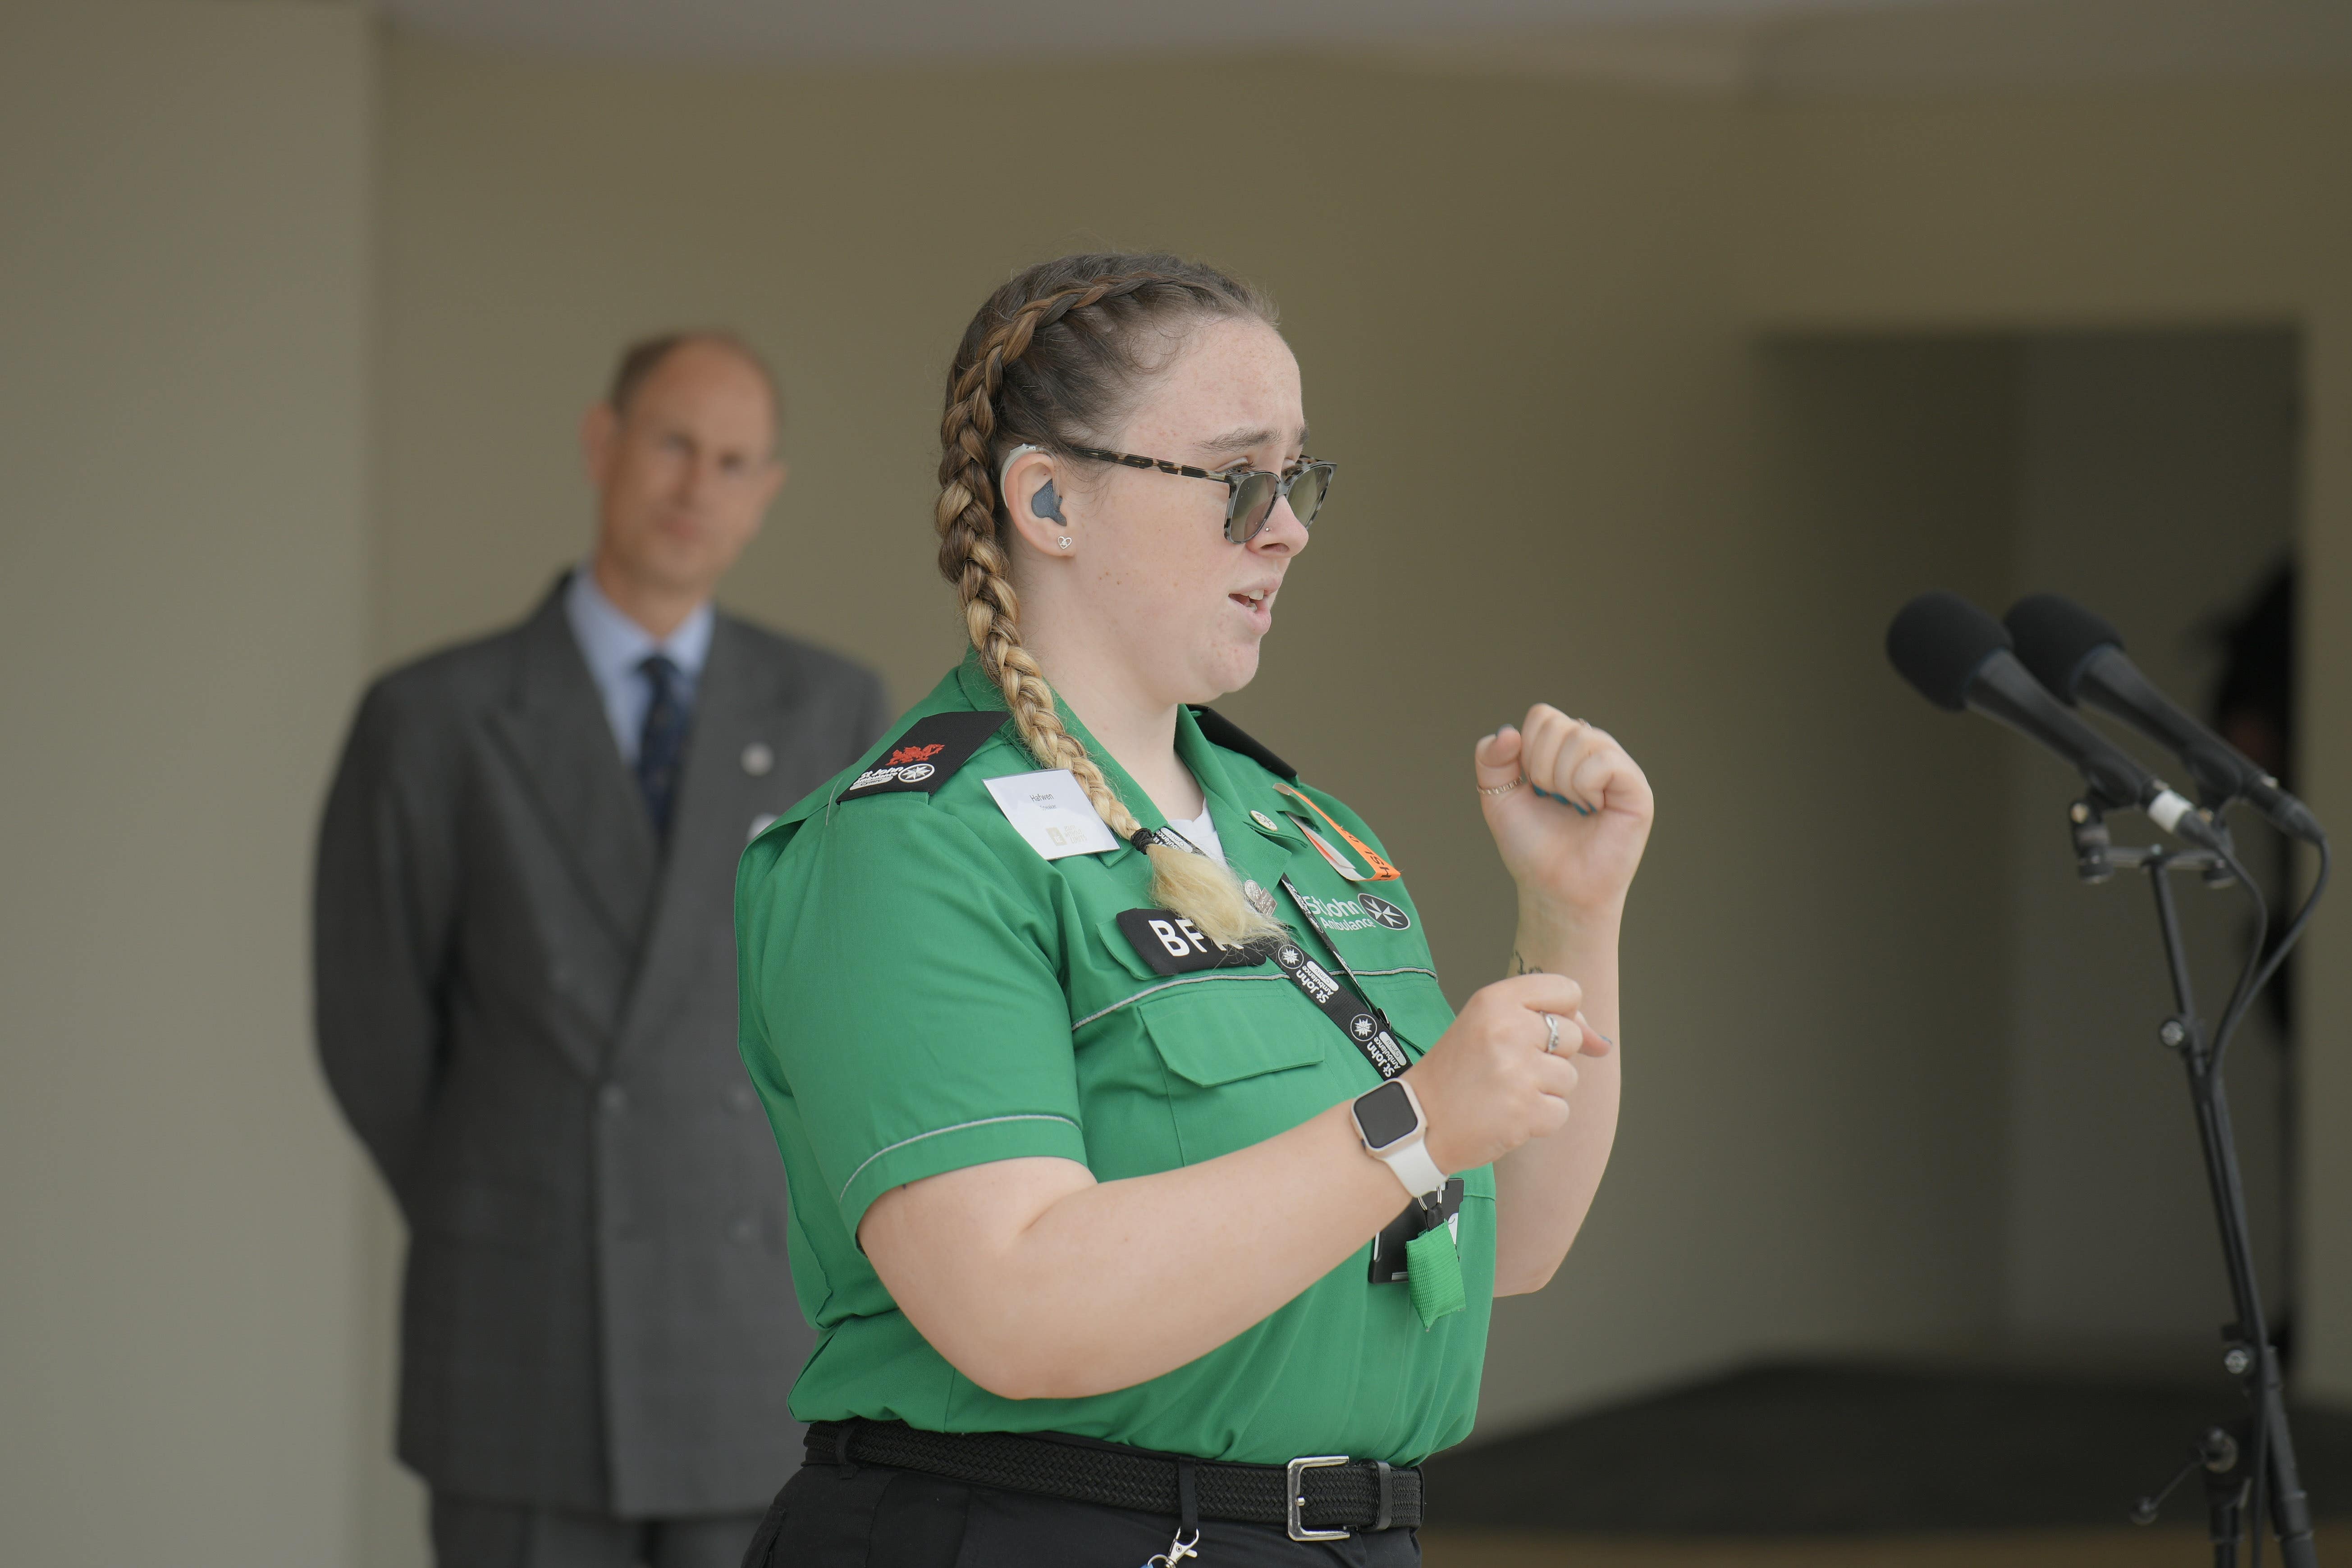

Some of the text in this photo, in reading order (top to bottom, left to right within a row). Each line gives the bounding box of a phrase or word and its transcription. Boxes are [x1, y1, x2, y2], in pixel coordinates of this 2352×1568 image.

[853, 772, 898, 785] Ambulance
[872, 767, 903, 777] John
[1029, 793, 1054, 802] Hafwen
[1318, 898, 1365, 917] John
[1320, 917, 1376, 931] Ambulance
[1148, 919, 1244, 957] BF
[1302, 965, 1334, 996] Ambulance
[1315, 969, 1331, 984] Cymru
[1296, 969, 1329, 1003] St John
[1373, 1037, 1401, 1069] Ambulance
[1386, 1040, 1400, 1057] Cymru
[1367, 1041, 1395, 1077] St John
